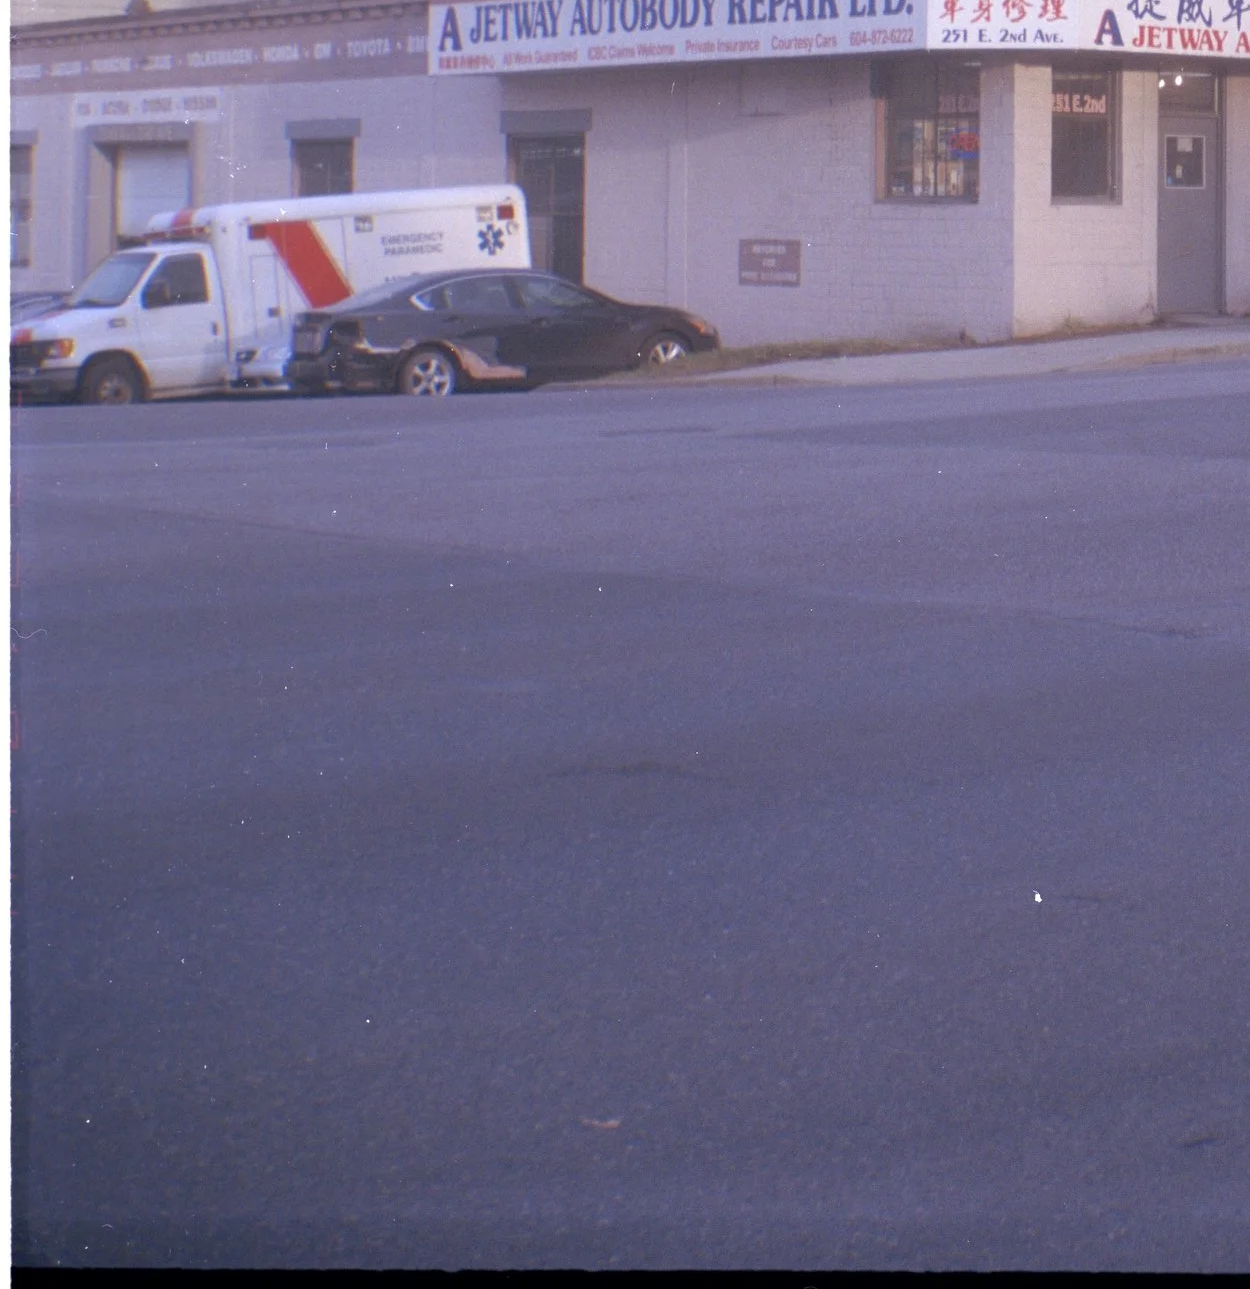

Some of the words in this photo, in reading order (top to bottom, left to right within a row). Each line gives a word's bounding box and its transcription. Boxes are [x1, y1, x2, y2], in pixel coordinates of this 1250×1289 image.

[438, 6, 462, 52] A
[942, 28, 967, 43] 251
[978, 29, 992, 43] E.
[1094, 9, 1124, 47] A
[1132, 25, 1228, 53] JETWAY
[347, 38, 391, 58] TOYOTA
[637, 43, 675, 57] Welcome
[685, 39, 714, 53] Private
[717, 39, 760, 52] Insurance
[771, 35, 813, 52] Courtesy
[816, 33, 838, 48] Cars
[381, 232, 444, 245] EMERGENCY
[384, 243, 443, 256] PARAMEDIC
